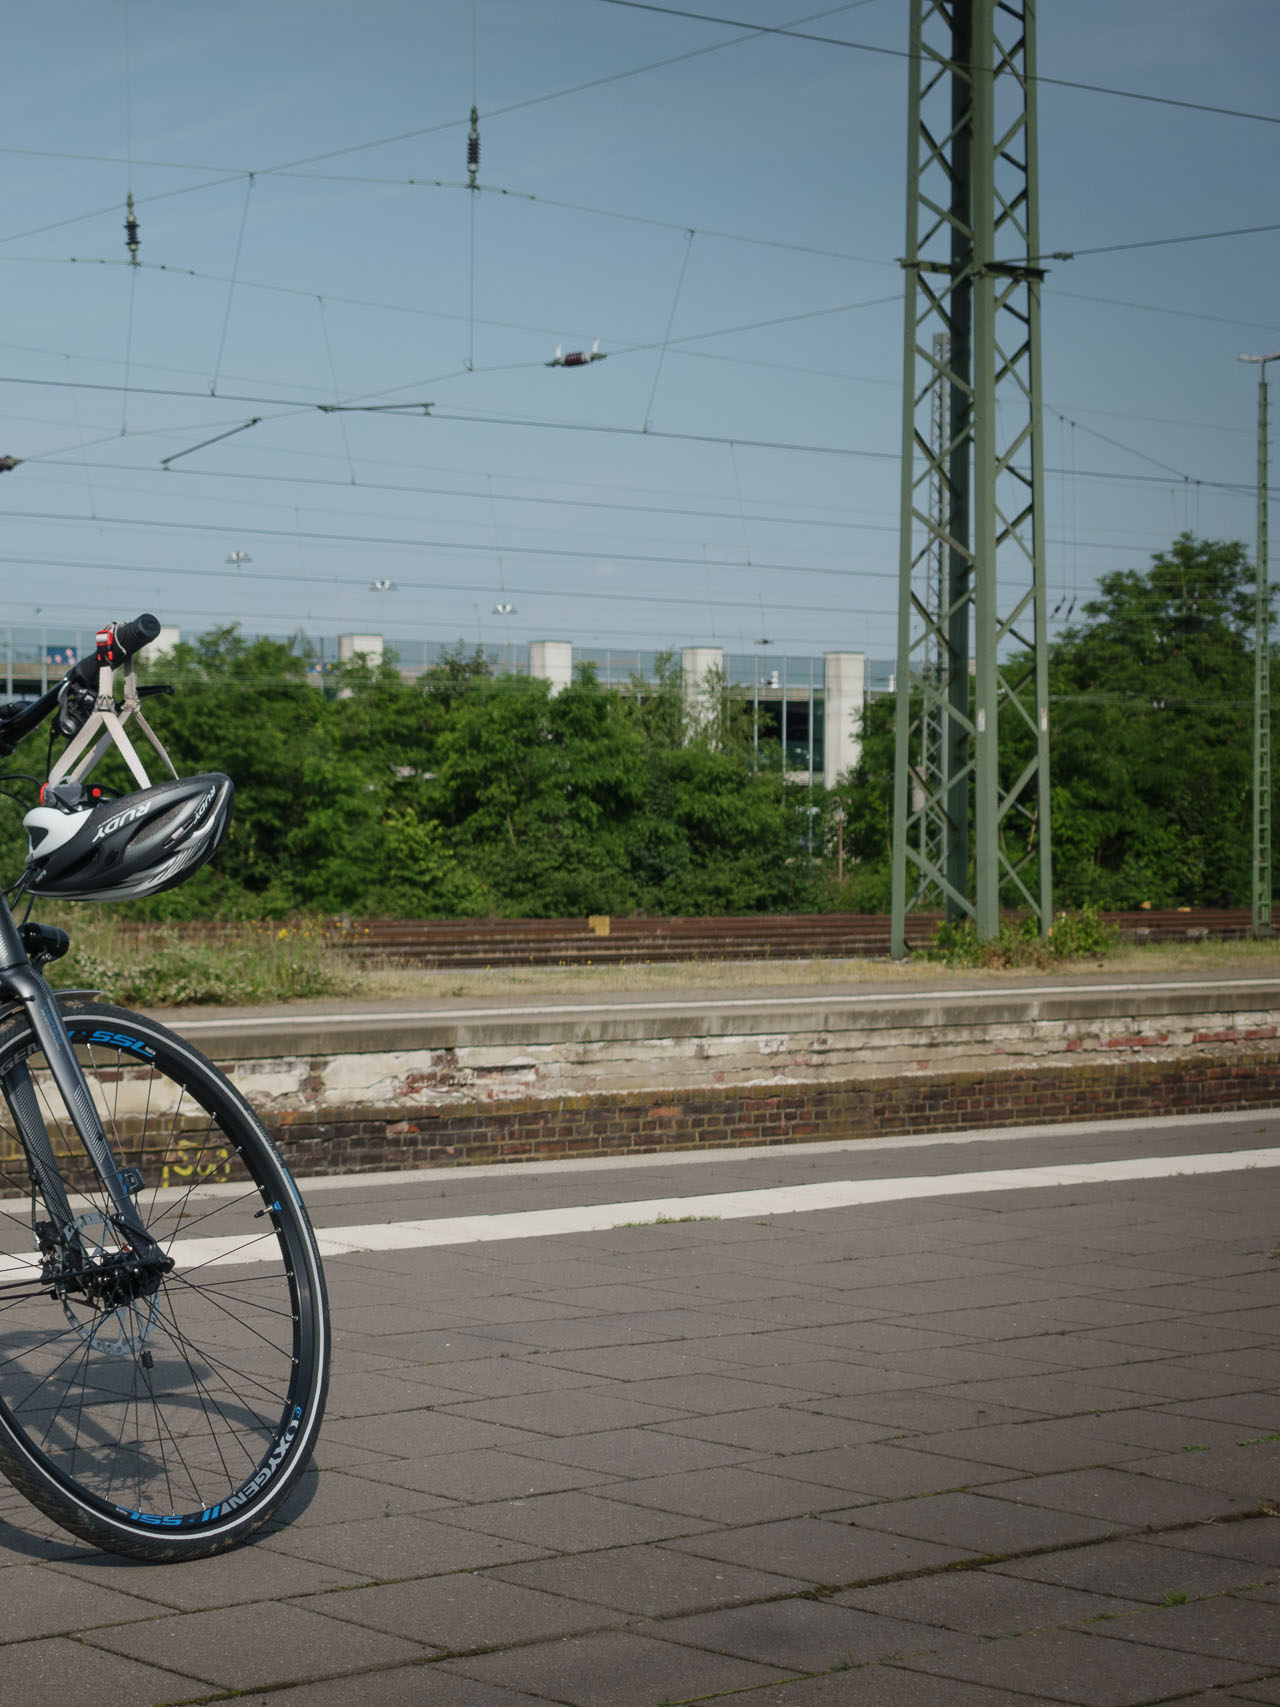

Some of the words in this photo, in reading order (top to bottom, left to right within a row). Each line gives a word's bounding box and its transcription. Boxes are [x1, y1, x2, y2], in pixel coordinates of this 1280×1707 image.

[92, 802, 152, 843] RUDY
[191, 785, 216, 824] RUDY
[88, 1030, 153, 1058] SSL
[228, 1419, 300, 1509] OXYGEN
[116, 1505, 184, 1526] SSL
